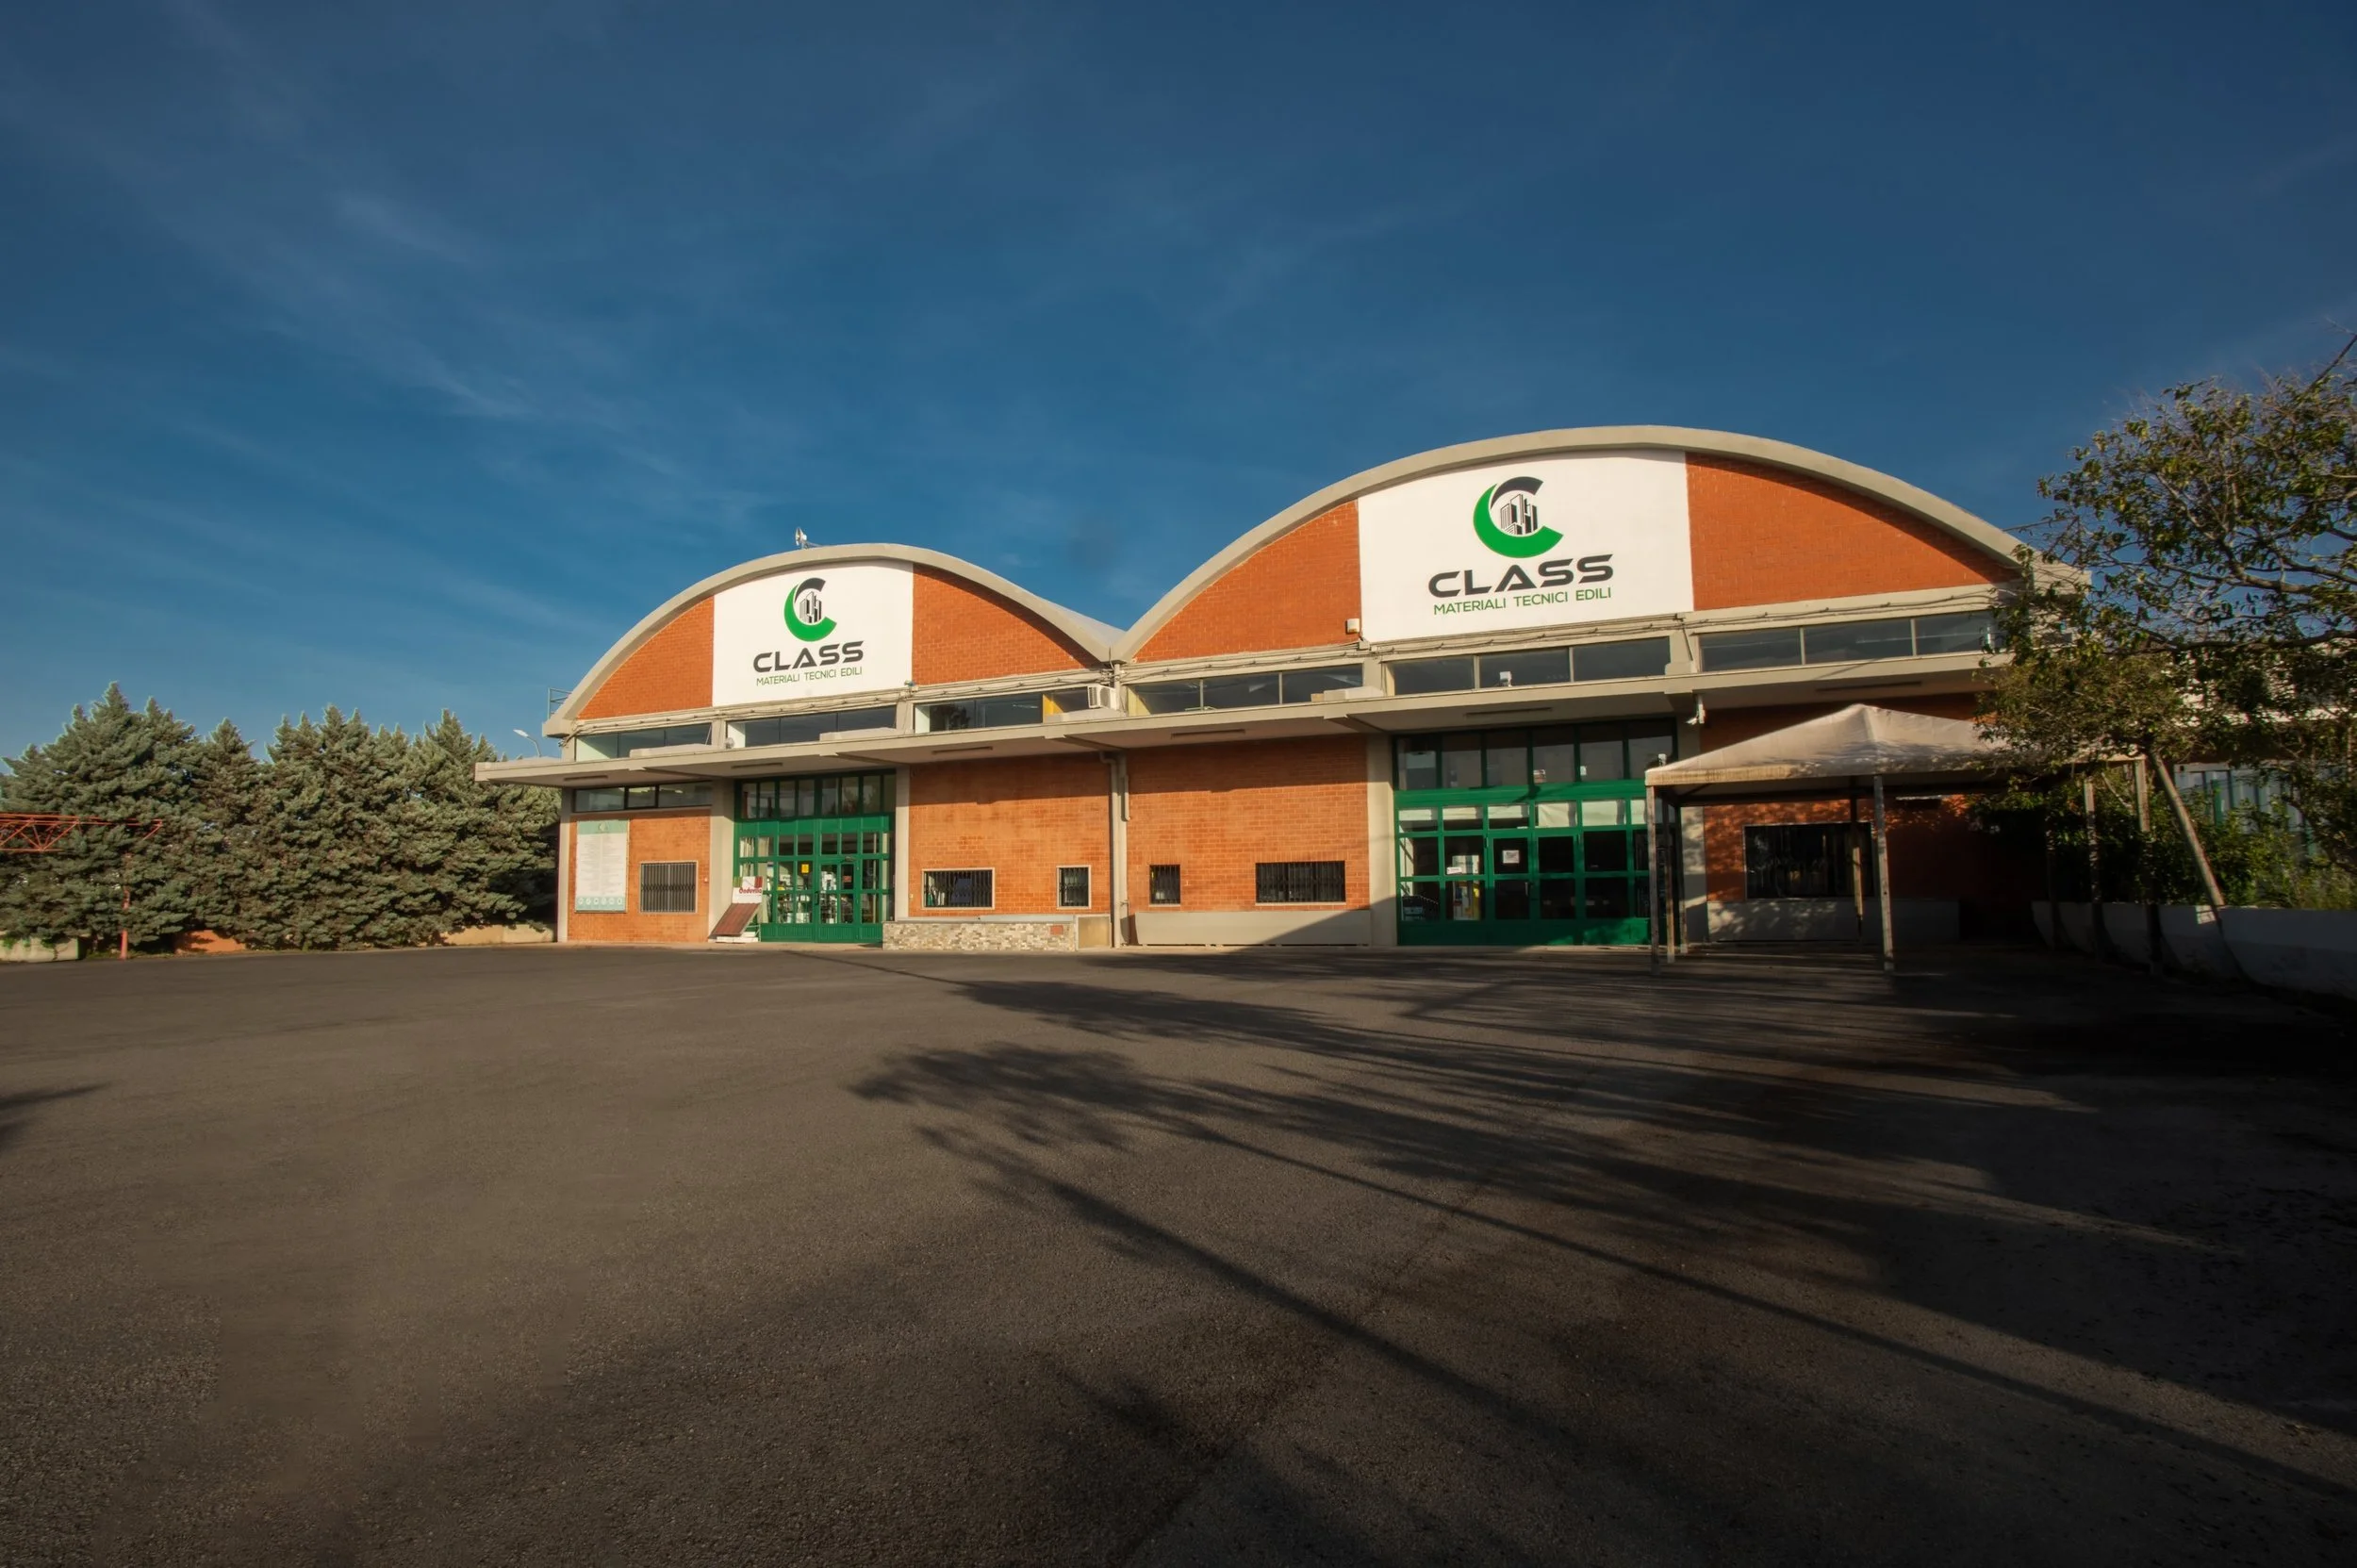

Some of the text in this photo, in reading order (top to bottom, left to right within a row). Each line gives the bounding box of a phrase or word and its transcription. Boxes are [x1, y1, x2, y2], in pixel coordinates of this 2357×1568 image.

[1427, 553, 1614, 599] CLASS
[1433, 586, 1612, 616] MATERIALI TECNICI EDILI
[752, 640, 865, 673] CLASS
[756, 667, 863, 686] MATERIALI TECNICI EDILI
